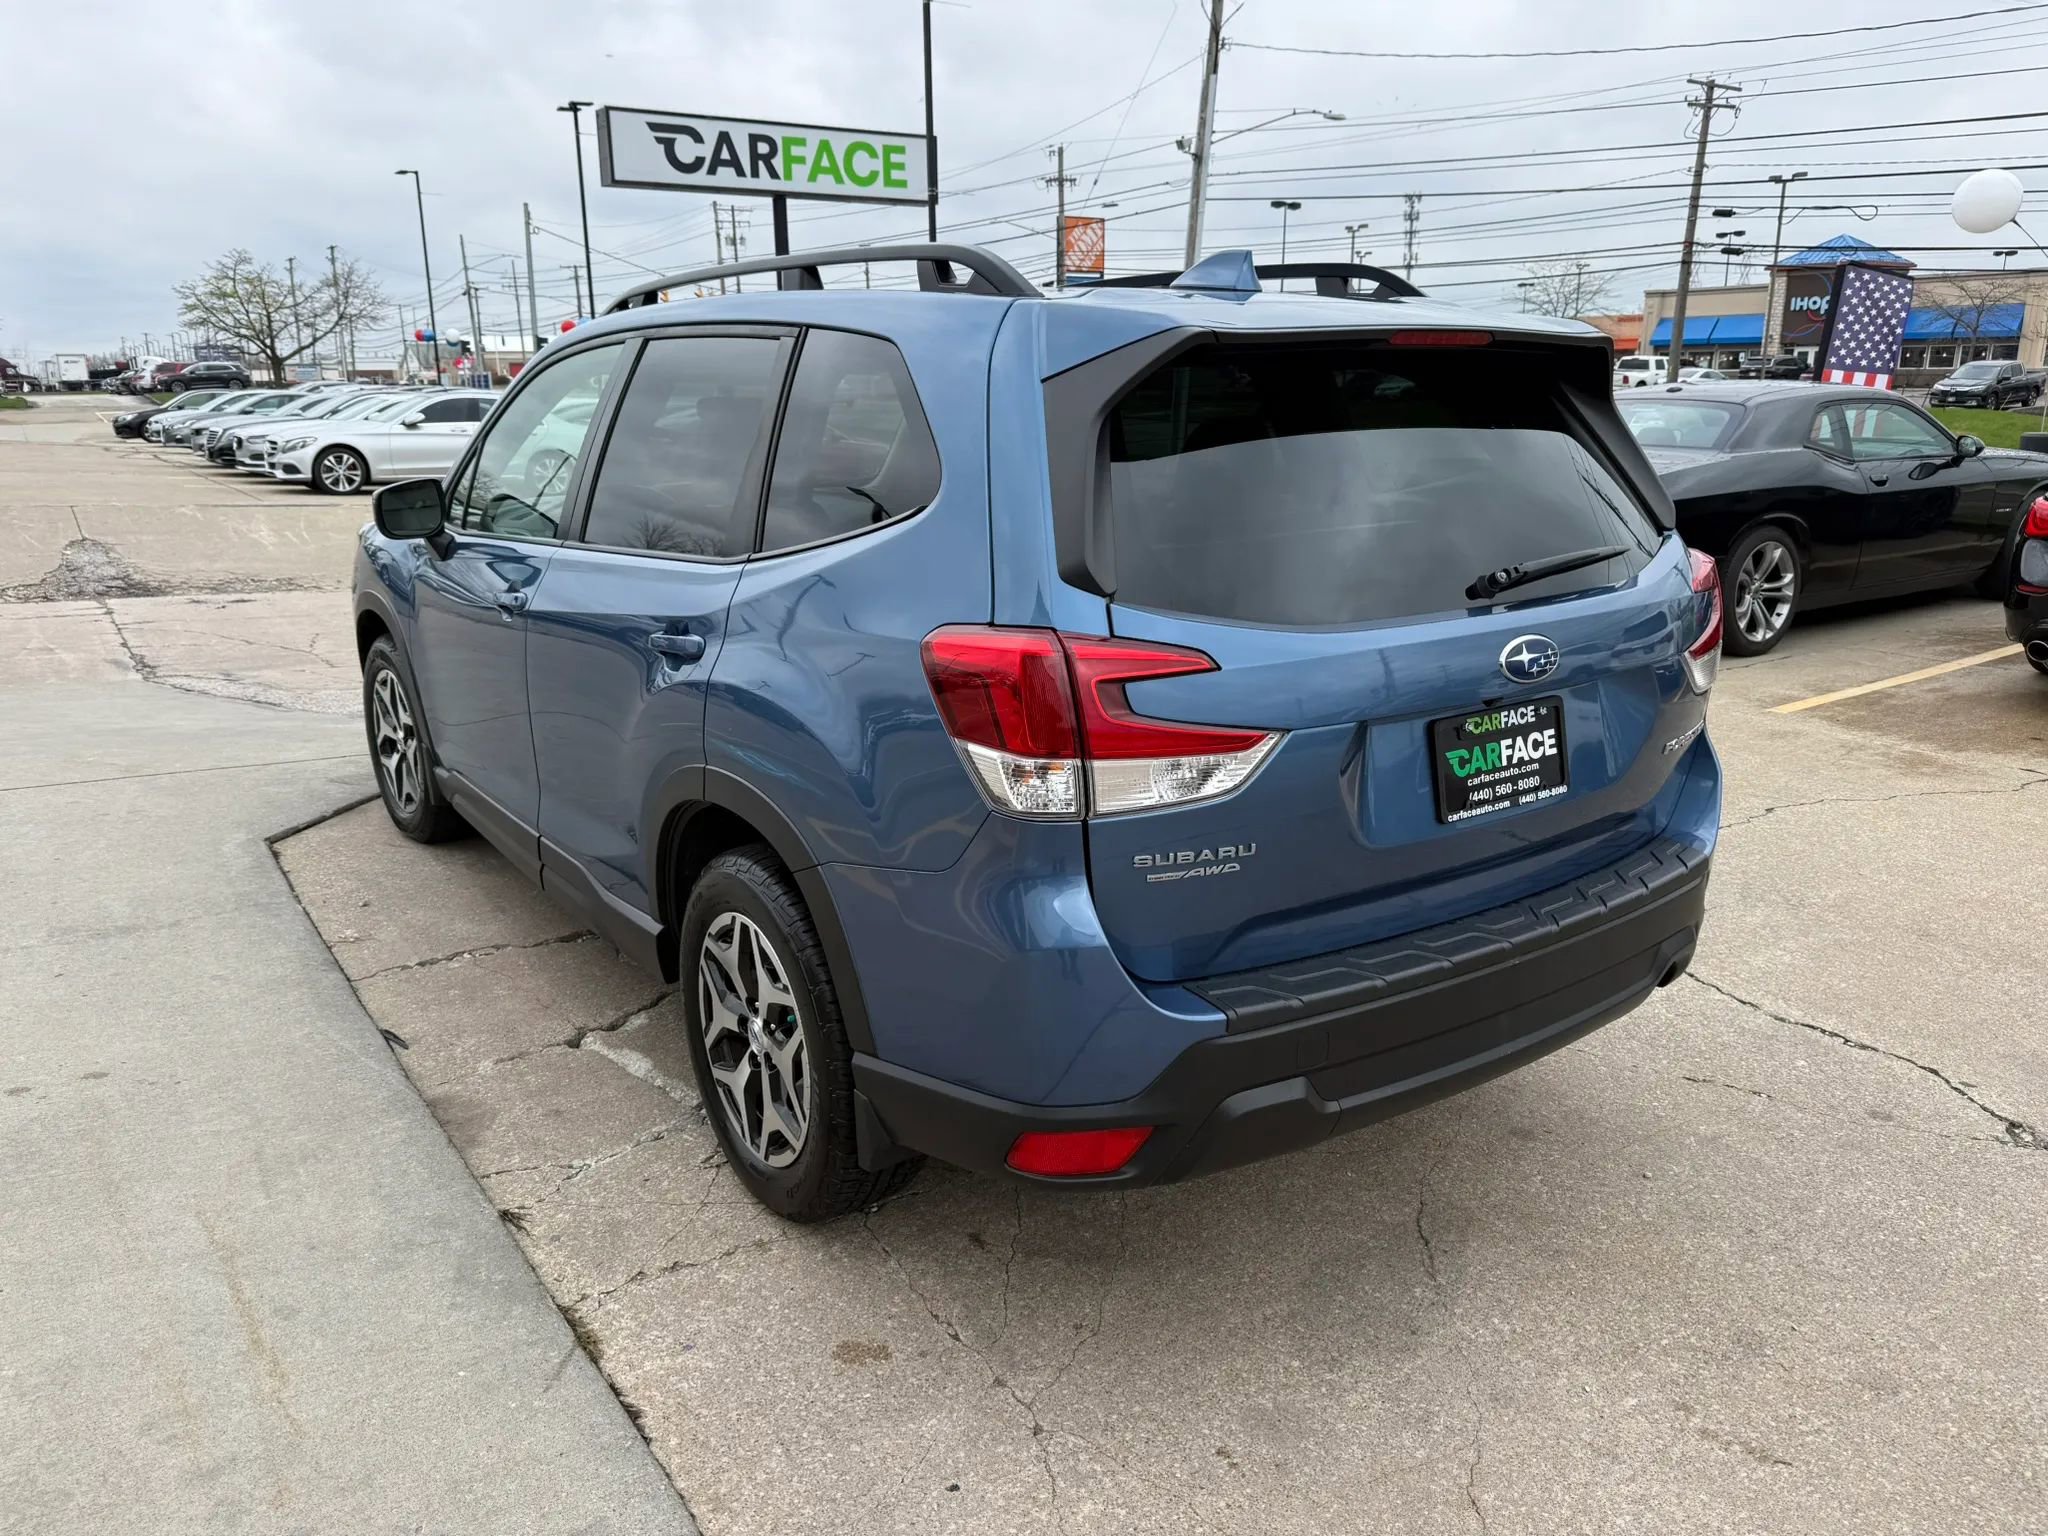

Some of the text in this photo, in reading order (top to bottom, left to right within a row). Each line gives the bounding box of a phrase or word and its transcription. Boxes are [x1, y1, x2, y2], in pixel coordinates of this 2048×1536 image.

[645, 121, 908, 188] CARFACE
[1467, 706, 1536, 734] CARFACE
[1445, 728, 1557, 777] CARFACE
[1467, 762, 1540, 786] carfaceauto.com
[1469, 776, 1540, 801] (440) 560-8080
[1448, 785, 1568, 822] carfaceauto.com (440) 560-8080
[1133, 843, 1257, 868] SUBARU
[1183, 862, 1241, 878] AWD
